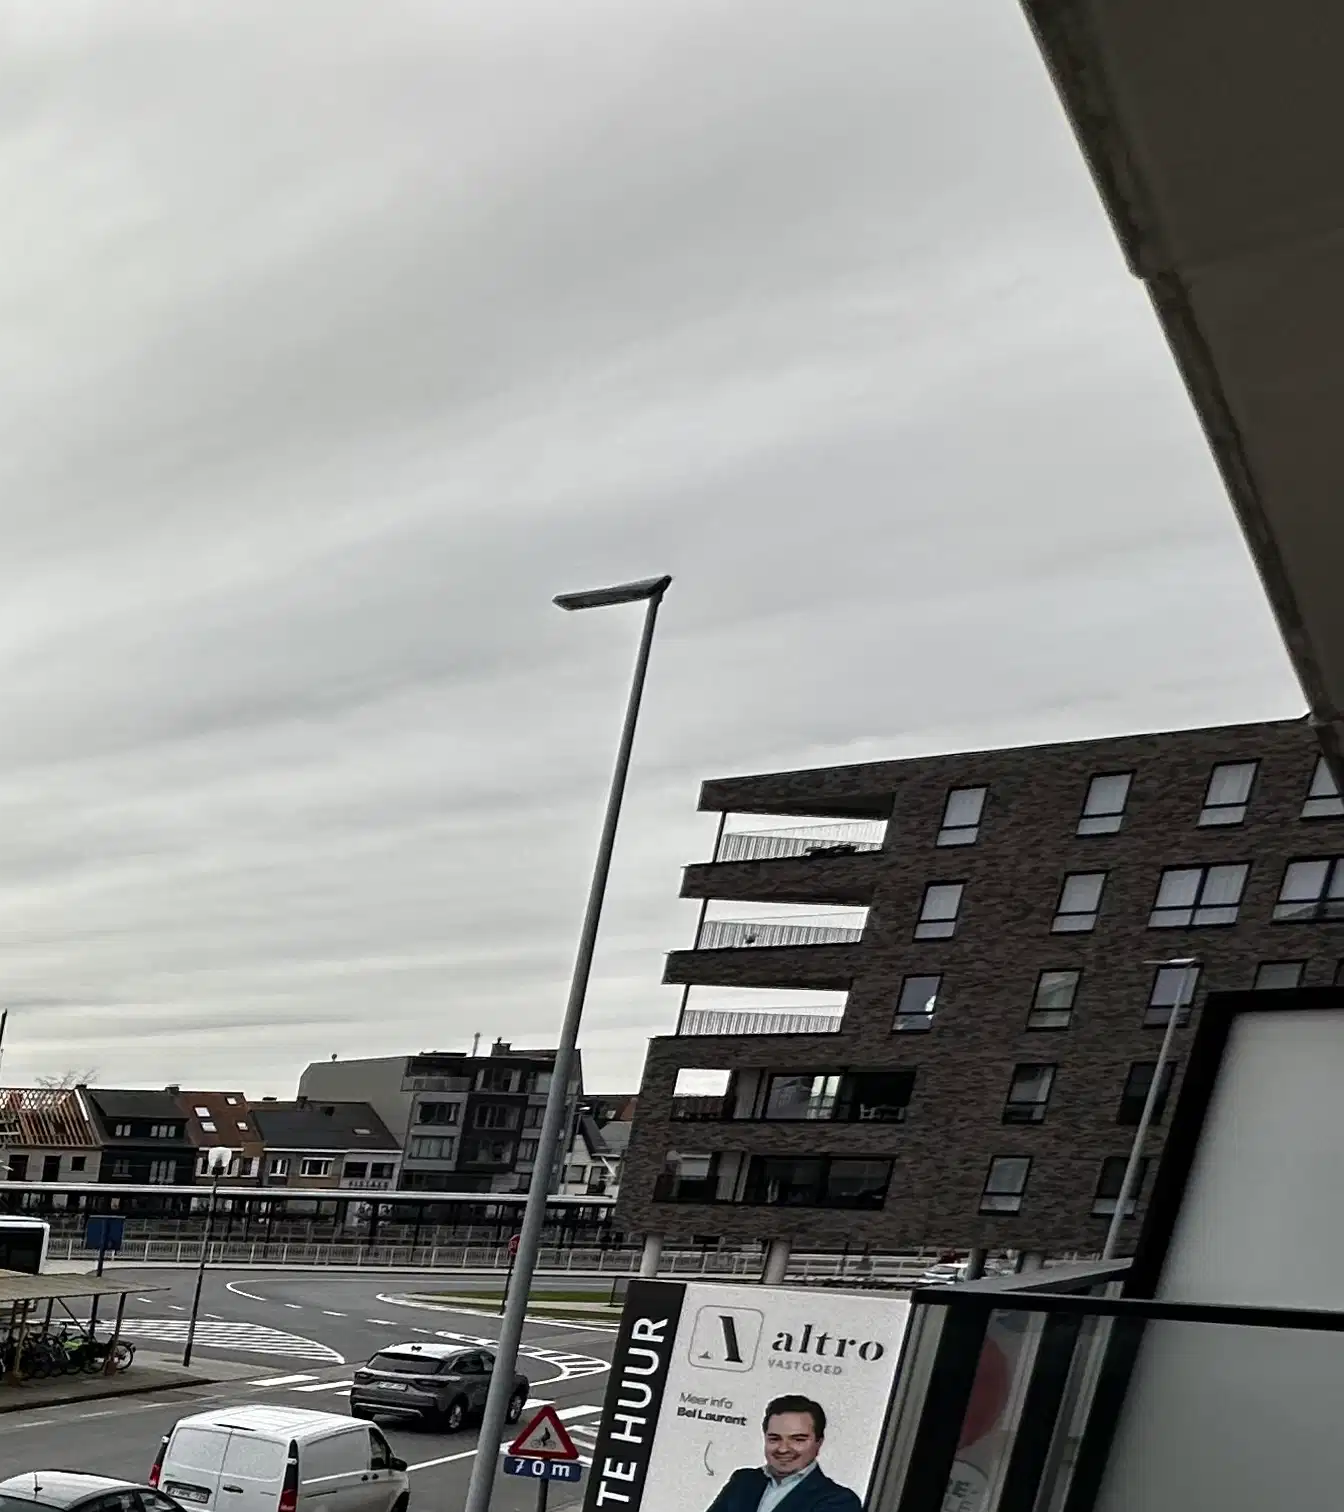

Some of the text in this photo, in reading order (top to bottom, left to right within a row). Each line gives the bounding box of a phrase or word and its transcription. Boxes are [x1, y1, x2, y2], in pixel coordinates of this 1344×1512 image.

[771, 1323, 885, 1362] altro
[767, 1358, 843, 1376] VASTGOED
[679, 1391, 734, 1410] Meer info
[596, 1317, 669, 1507] TE HUUR
[676, 1406, 748, 1426] Bel Laurent
[514, 1458, 570, 1477] 70 m
